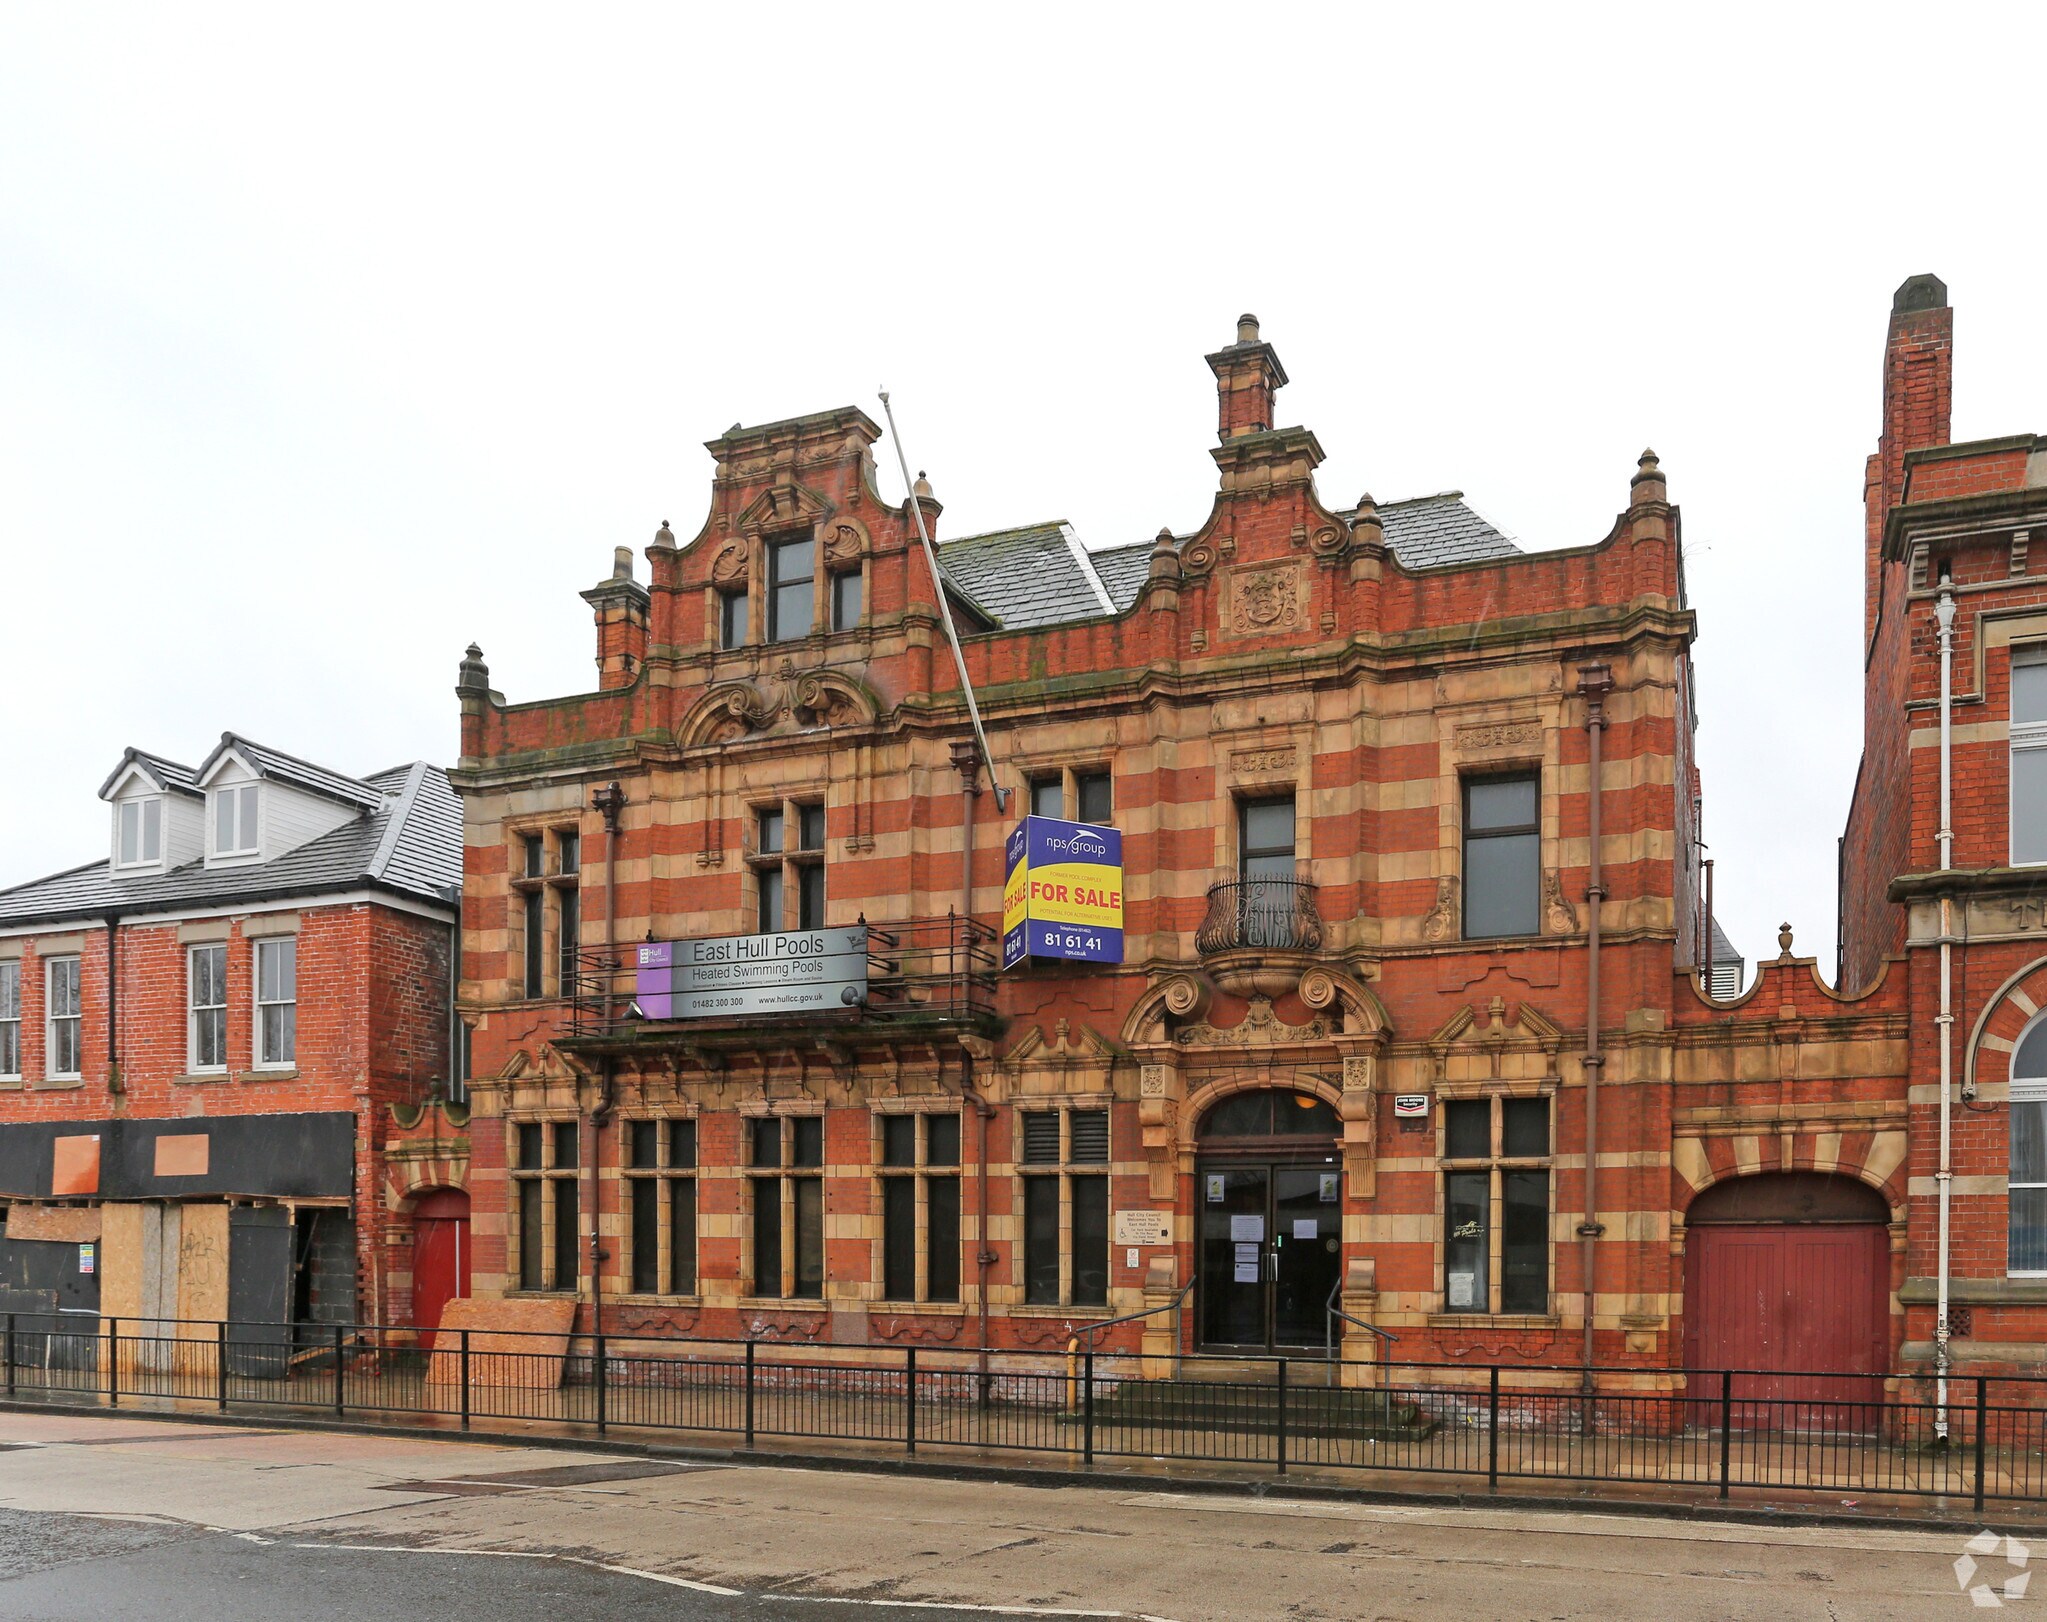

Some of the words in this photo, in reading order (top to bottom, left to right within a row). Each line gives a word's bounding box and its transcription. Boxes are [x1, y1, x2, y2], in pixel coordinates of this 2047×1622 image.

[1046, 837, 1067, 851] nps
[1071, 841, 1106, 858] group
[1004, 893, 1014, 915] FOR
[1014, 881, 1027, 907] SALE
[1031, 881, 1068, 903] FOR
[1074, 887, 1121, 909] SALE
[1040, 908, 1063, 916] POTENTIAL
[693, 942, 731, 961] East
[737, 938, 769, 958] Hull
[775, 934, 824, 956] Pools
[1045, 932, 1060, 946] 81
[1065, 935, 1081, 949] 61
[1085, 937, 1101, 950] 41
[648, 948, 662, 956] Hull
[692, 966, 730, 981] Heated
[733, 962, 789, 977] Swimming
[793, 960, 823, 973] Pools
[692, 999, 714, 1009] 01482
[715, 998, 729, 1007] 300
[730, 997, 744, 1006] 300
[758, 993, 823, 1004] www.hullcc.gov.uk
